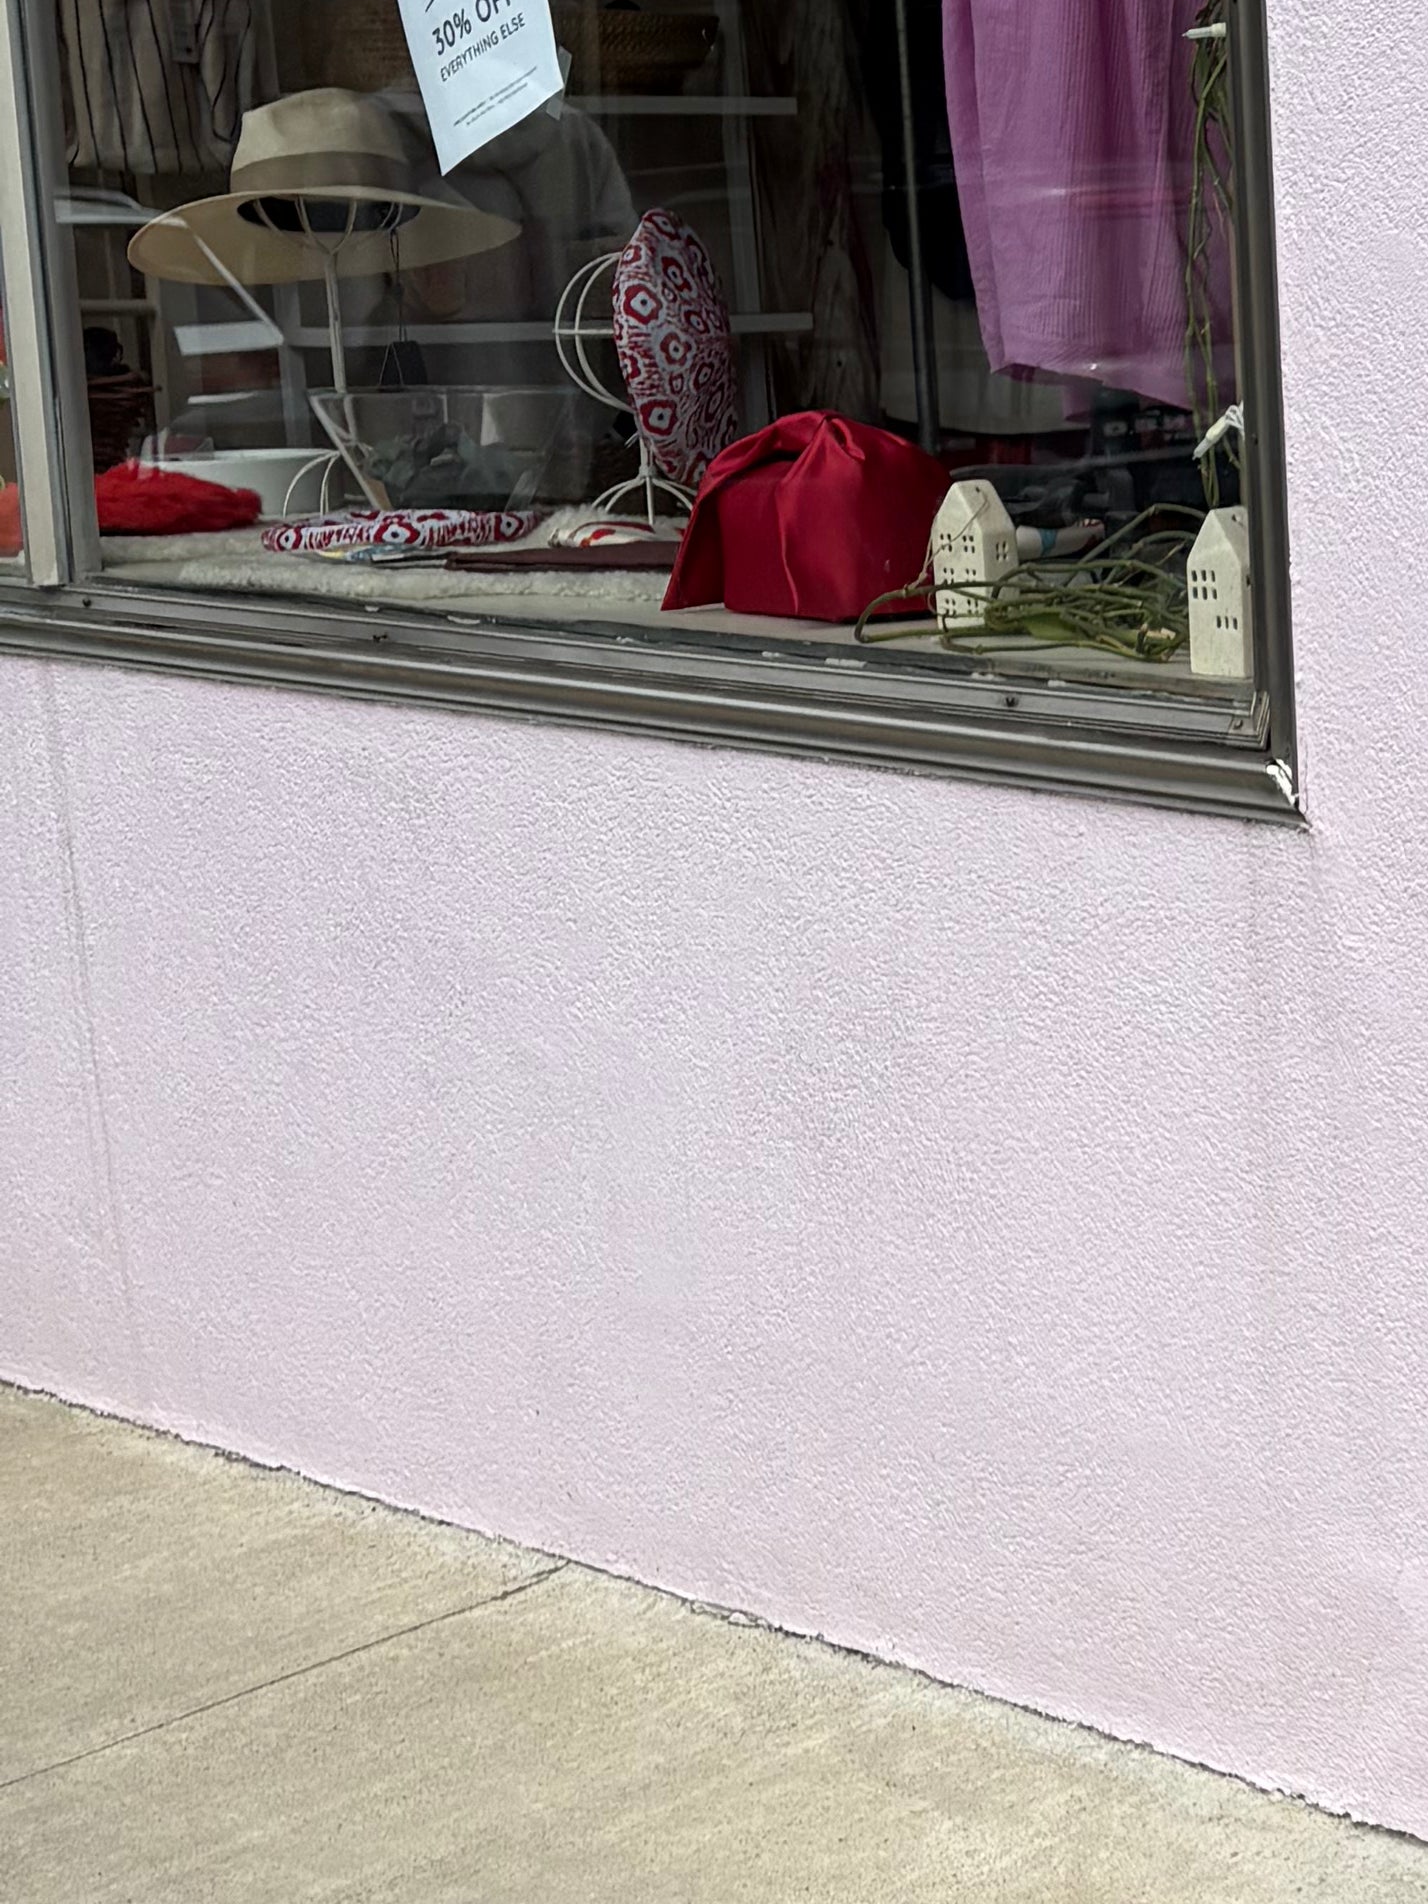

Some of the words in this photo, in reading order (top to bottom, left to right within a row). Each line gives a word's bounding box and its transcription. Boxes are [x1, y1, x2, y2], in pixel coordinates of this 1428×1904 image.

[431, 8, 472, 56] 30%
[440, 33, 500, 83] EVERYTHING
[501, 11, 526, 42] ELSE
